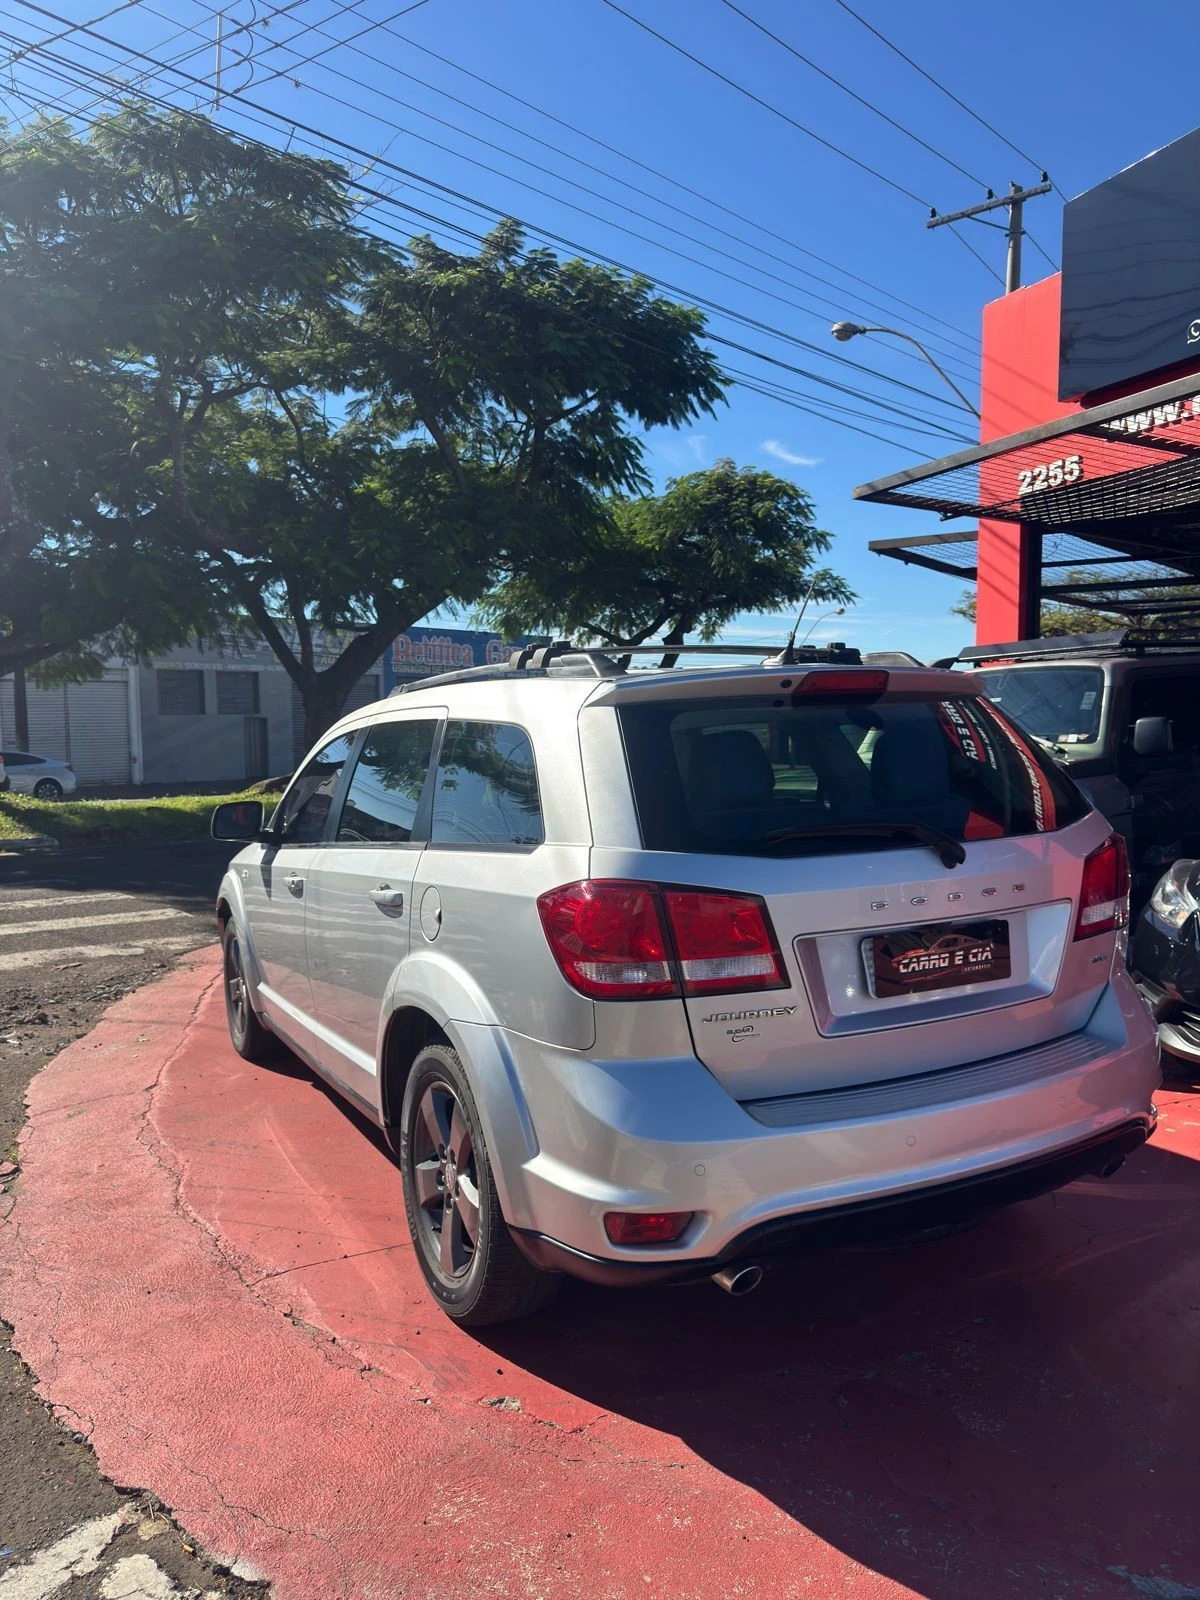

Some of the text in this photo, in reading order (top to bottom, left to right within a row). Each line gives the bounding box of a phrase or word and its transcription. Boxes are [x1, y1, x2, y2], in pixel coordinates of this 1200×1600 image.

[1018, 455, 1081, 496] 2255
[870, 883, 1026, 911] DODGE
[898, 952, 949, 974] CARRO
[954, 950, 965, 966] E
[701, 1005, 798, 1024] JOURNEY
